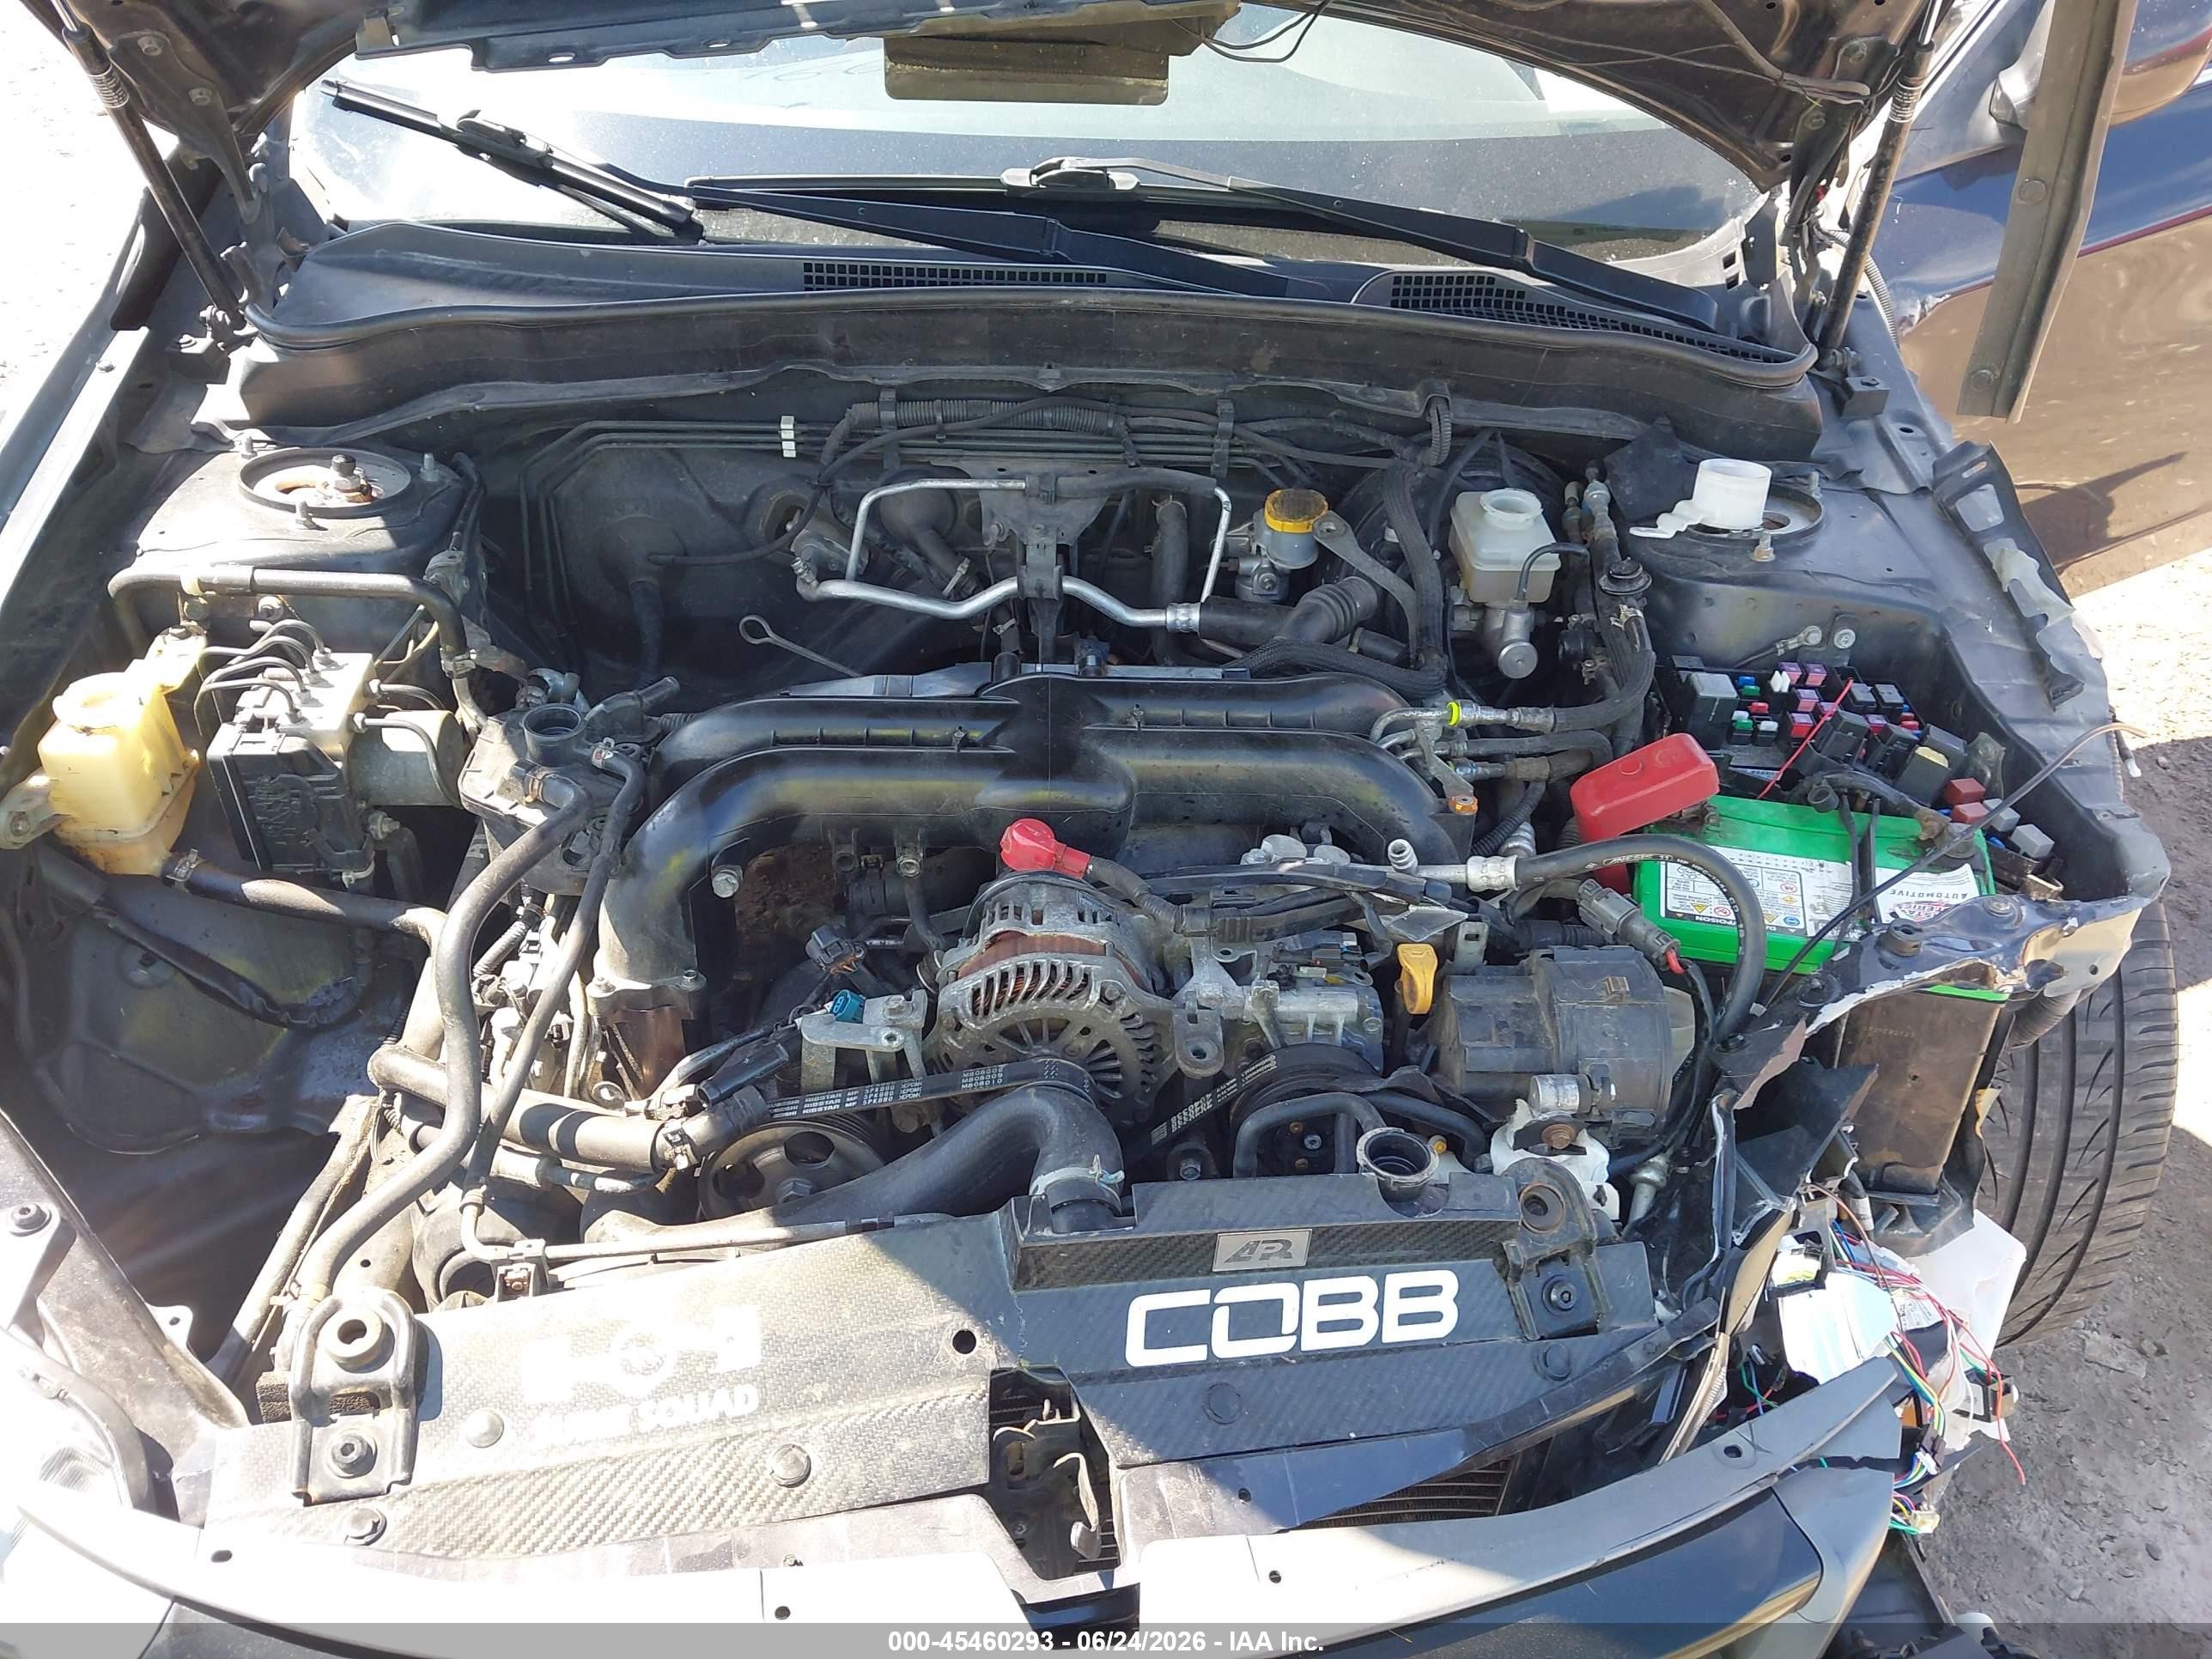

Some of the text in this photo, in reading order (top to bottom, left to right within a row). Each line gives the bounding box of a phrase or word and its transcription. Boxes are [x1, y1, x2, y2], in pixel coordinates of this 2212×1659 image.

[1889, 889, 1968, 900] AUTOMOTIVE
[802, 1104, 840, 1114] RIBSTAR
[804, 1098, 841, 1109] RIBSTAR
[1125, 1269, 1459, 1367] COBB
